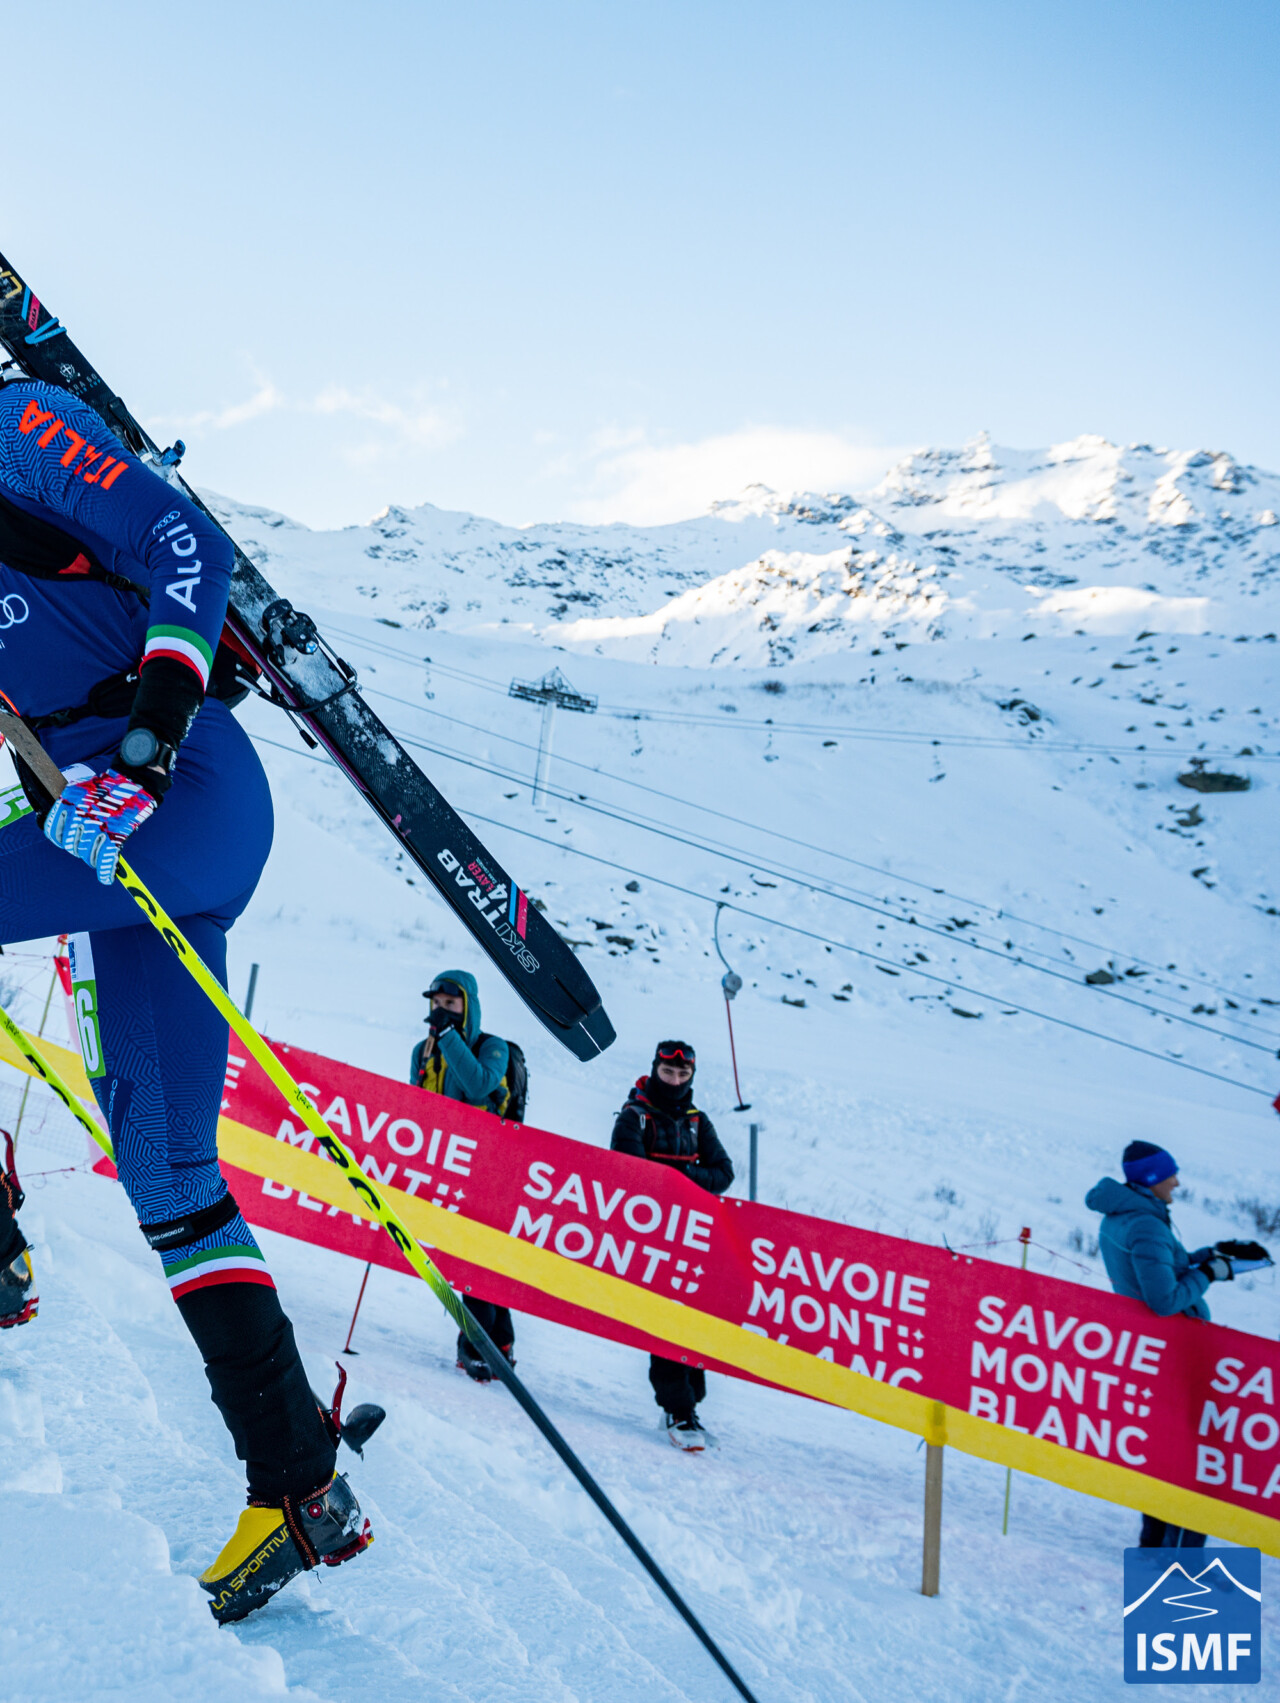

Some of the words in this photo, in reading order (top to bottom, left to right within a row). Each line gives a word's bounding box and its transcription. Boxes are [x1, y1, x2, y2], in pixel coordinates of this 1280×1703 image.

[159, 522, 202, 614] Audi
[467, 861, 495, 892] LAYER
[288, 1082, 478, 1177] SAVOIE
[508, 1205, 671, 1284] MONT
[523, 1161, 714, 1252] SAVOIE
[747, 1280, 891, 1352] MONT
[751, 1237, 930, 1316] SAVOIE
[974, 1296, 1167, 1375] SAVOIE
[971, 1340, 1120, 1411] MONT
[1210, 1357, 1274, 1405] SA
[968, 1385, 1149, 1465] BLANC
[1198, 1400, 1280, 1451] MO
[211, 1590, 233, 1610] LA
